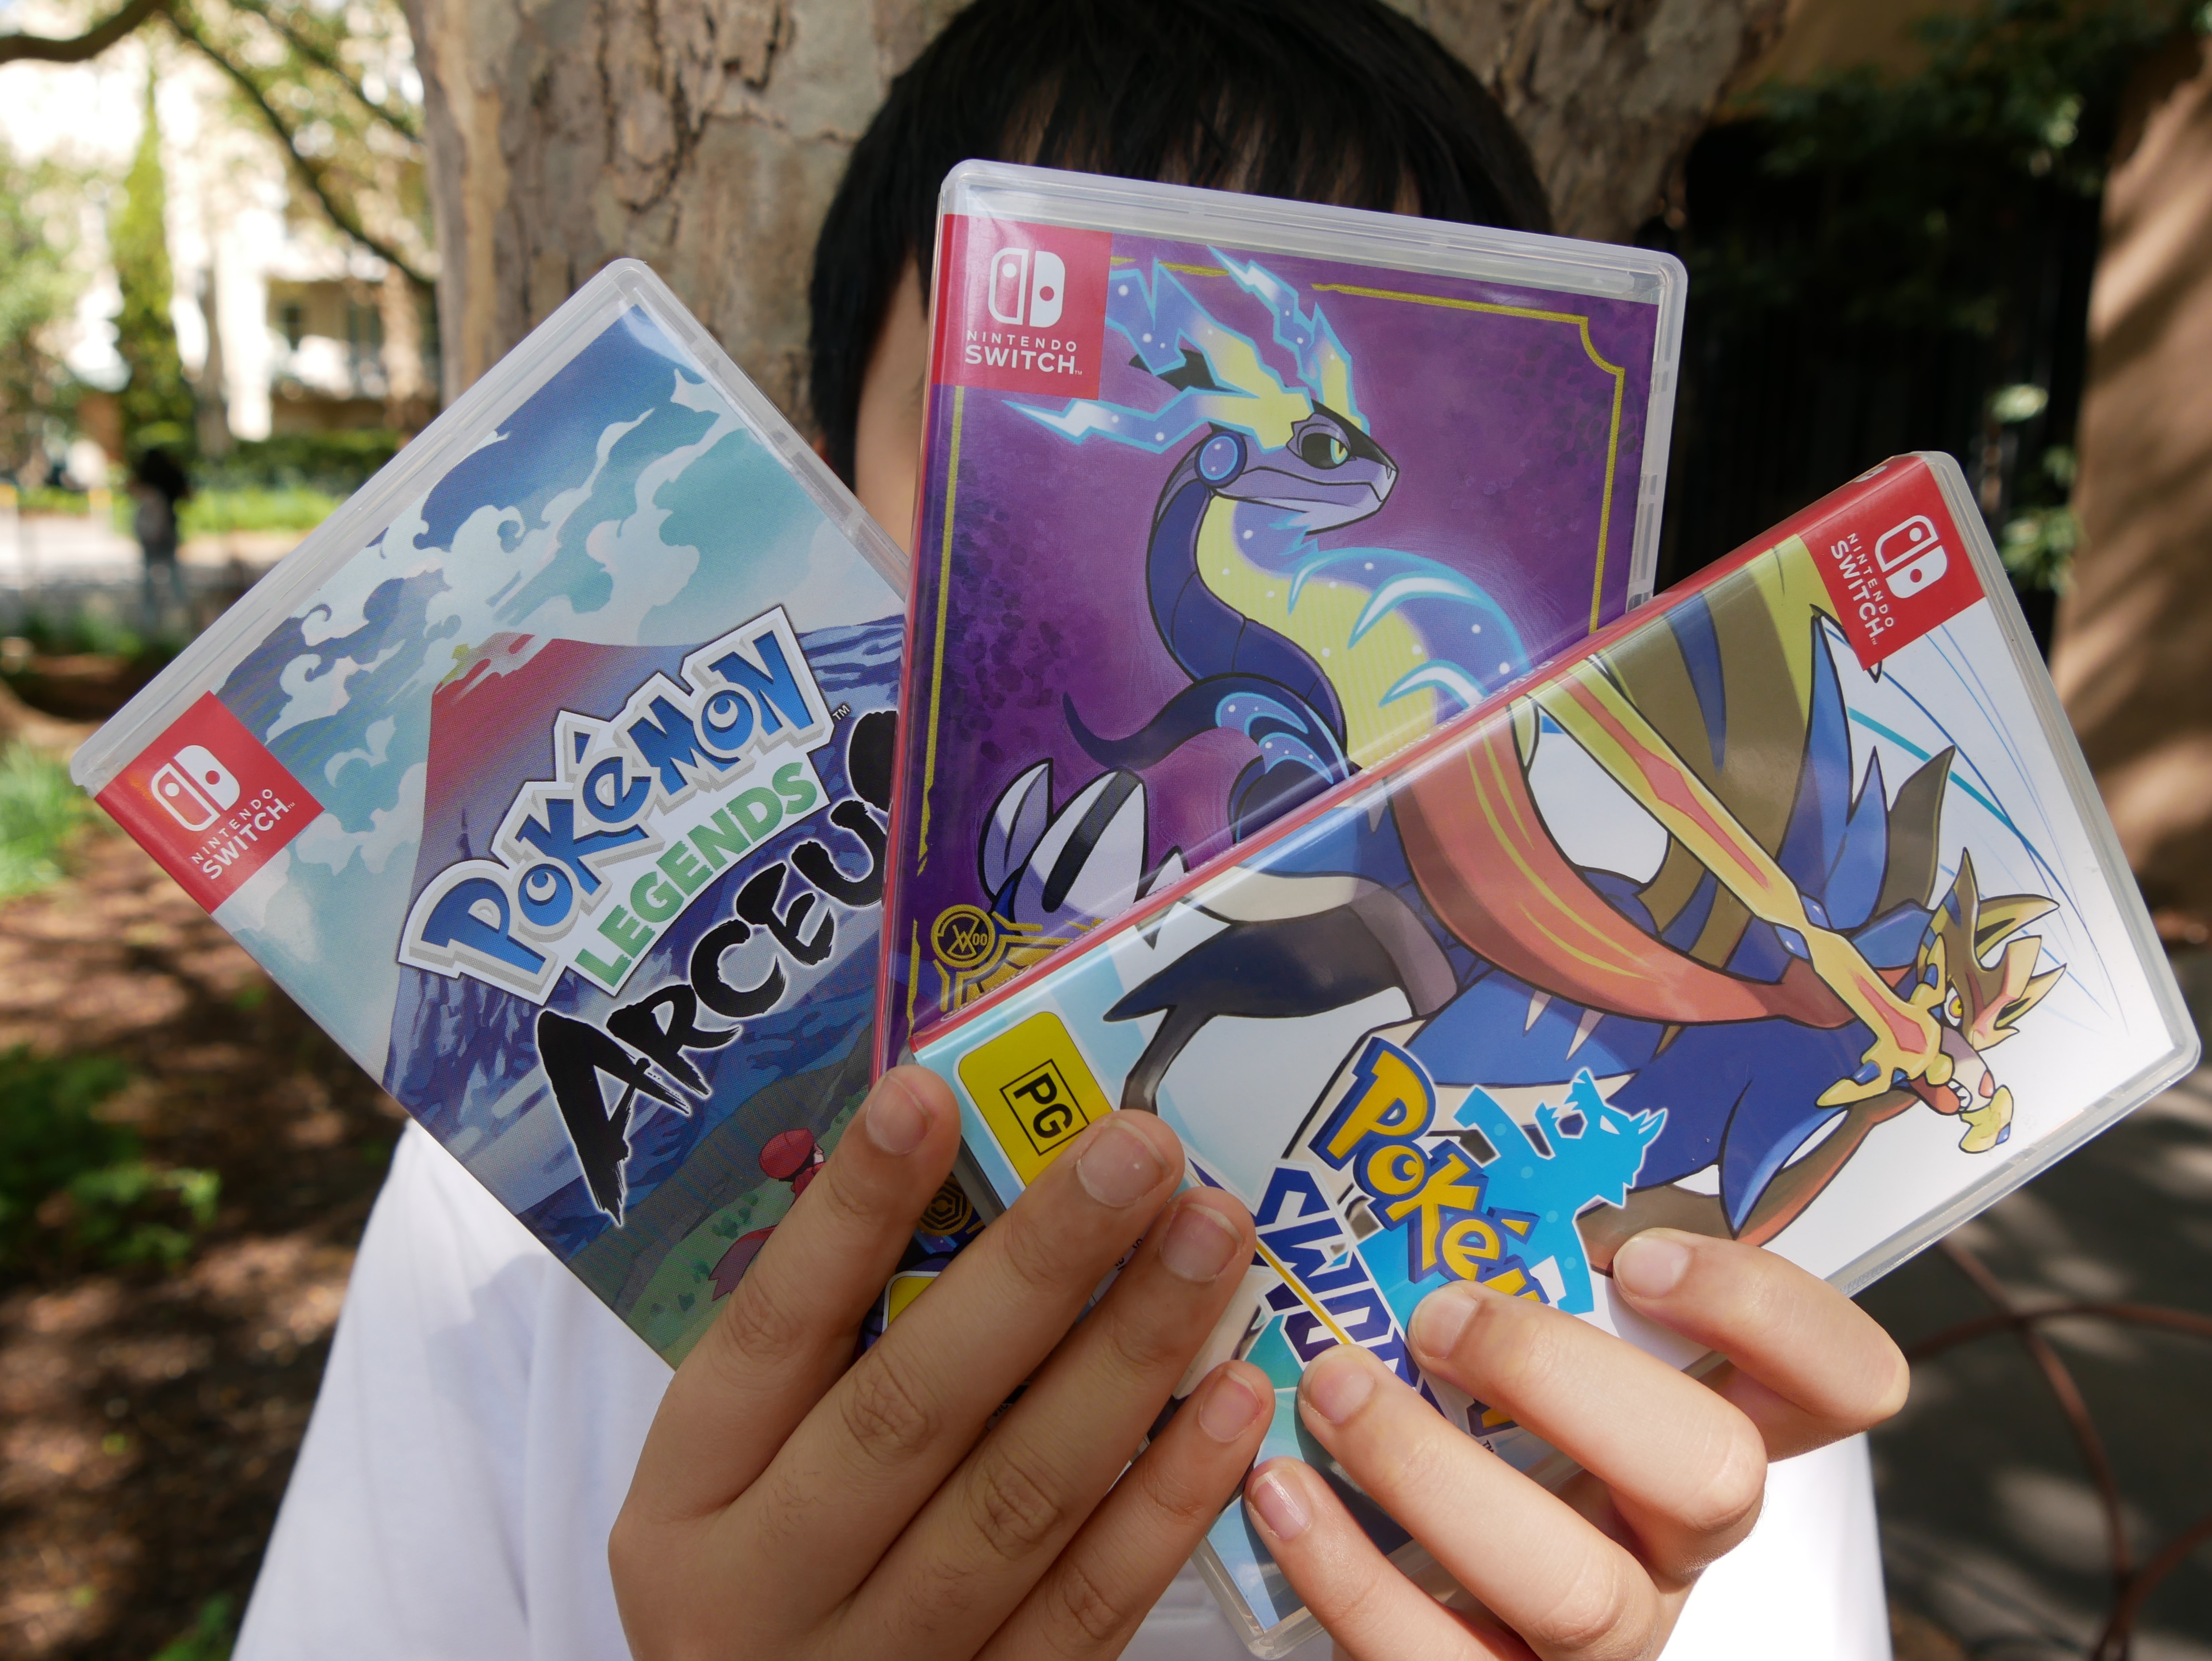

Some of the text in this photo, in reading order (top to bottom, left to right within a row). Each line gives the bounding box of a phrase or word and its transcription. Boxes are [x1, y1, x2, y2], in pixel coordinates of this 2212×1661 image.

[965, 344, 1076, 374] SWITCH
[966, 330, 1077, 352] NINTENDO
[1831, 540, 1884, 638] SWITCH
[1847, 532, 1894, 627] NINTENDO
[191, 789, 273, 864] NINTENDO
[202, 798, 289, 880] SWITCH
[576, 760, 819, 989] LEGENDS
[1012, 1071, 1073, 1139] PG
